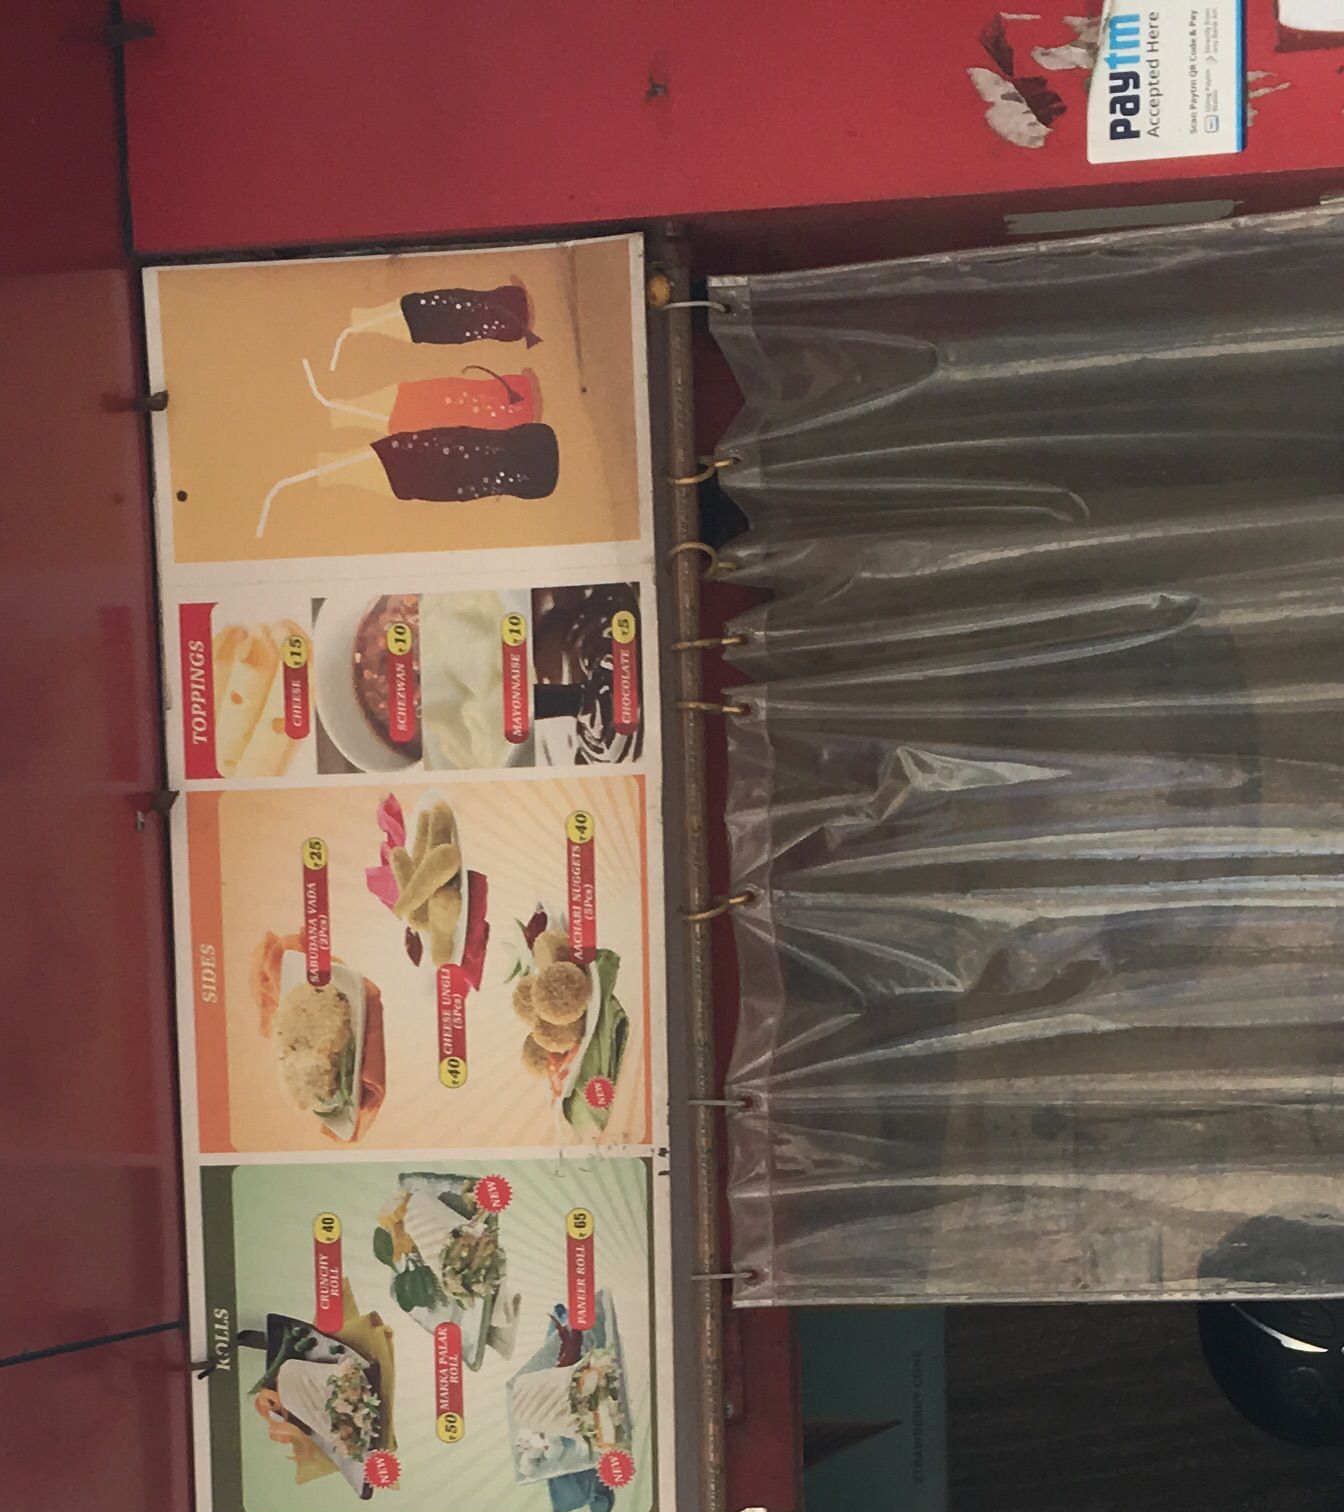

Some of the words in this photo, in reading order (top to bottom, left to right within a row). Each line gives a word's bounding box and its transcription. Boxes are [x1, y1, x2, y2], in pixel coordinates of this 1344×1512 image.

[1146, 11, 1160, 53] Here
[1189, 9, 1198, 27] Pay
[1189, 38, 1197, 61] Code
[1189, 64, 1198, 78] QR
[1146, 58, 1163, 137] Accepted
[1189, 112, 1198, 134] Scan
[188, 639, 208, 745] TOPPINGS
[290, 679, 303, 727] CHEESE
[394, 663, 409, 732] SCHEZWAN
[509, 653, 523, 736] MAYONNAISE
[619, 649, 632, 724] CHOCOLATE
[570, 845, 582, 904] NUGGETS
[307, 882, 318, 914] VADA
[308, 917, 320, 983] SABUDANA
[572, 907, 583, 960] AACHARI
[200, 943, 218, 1003] SIDES
[440, 967, 452, 1007] UNGLI
[442, 1010, 454, 1055] CHEESE
[592, 1080, 606, 1105] NEW
[485, 1181, 501, 1208] NEW
[319, 1253, 330, 1310] CRUNCHY
[329, 1266, 340, 1297] ROLL
[575, 1244, 586, 1276] ROLL
[575, 1279, 587, 1324] PANEER
[213, 1308, 231, 1371] ROLLS
[437, 1327, 449, 1365] PALAK
[438, 1366, 450, 1411] MAKKA
[448, 1354, 459, 1384] ROLL
[375, 1455, 390, 1484] NEW
[609, 1455, 624, 1483] NEW
